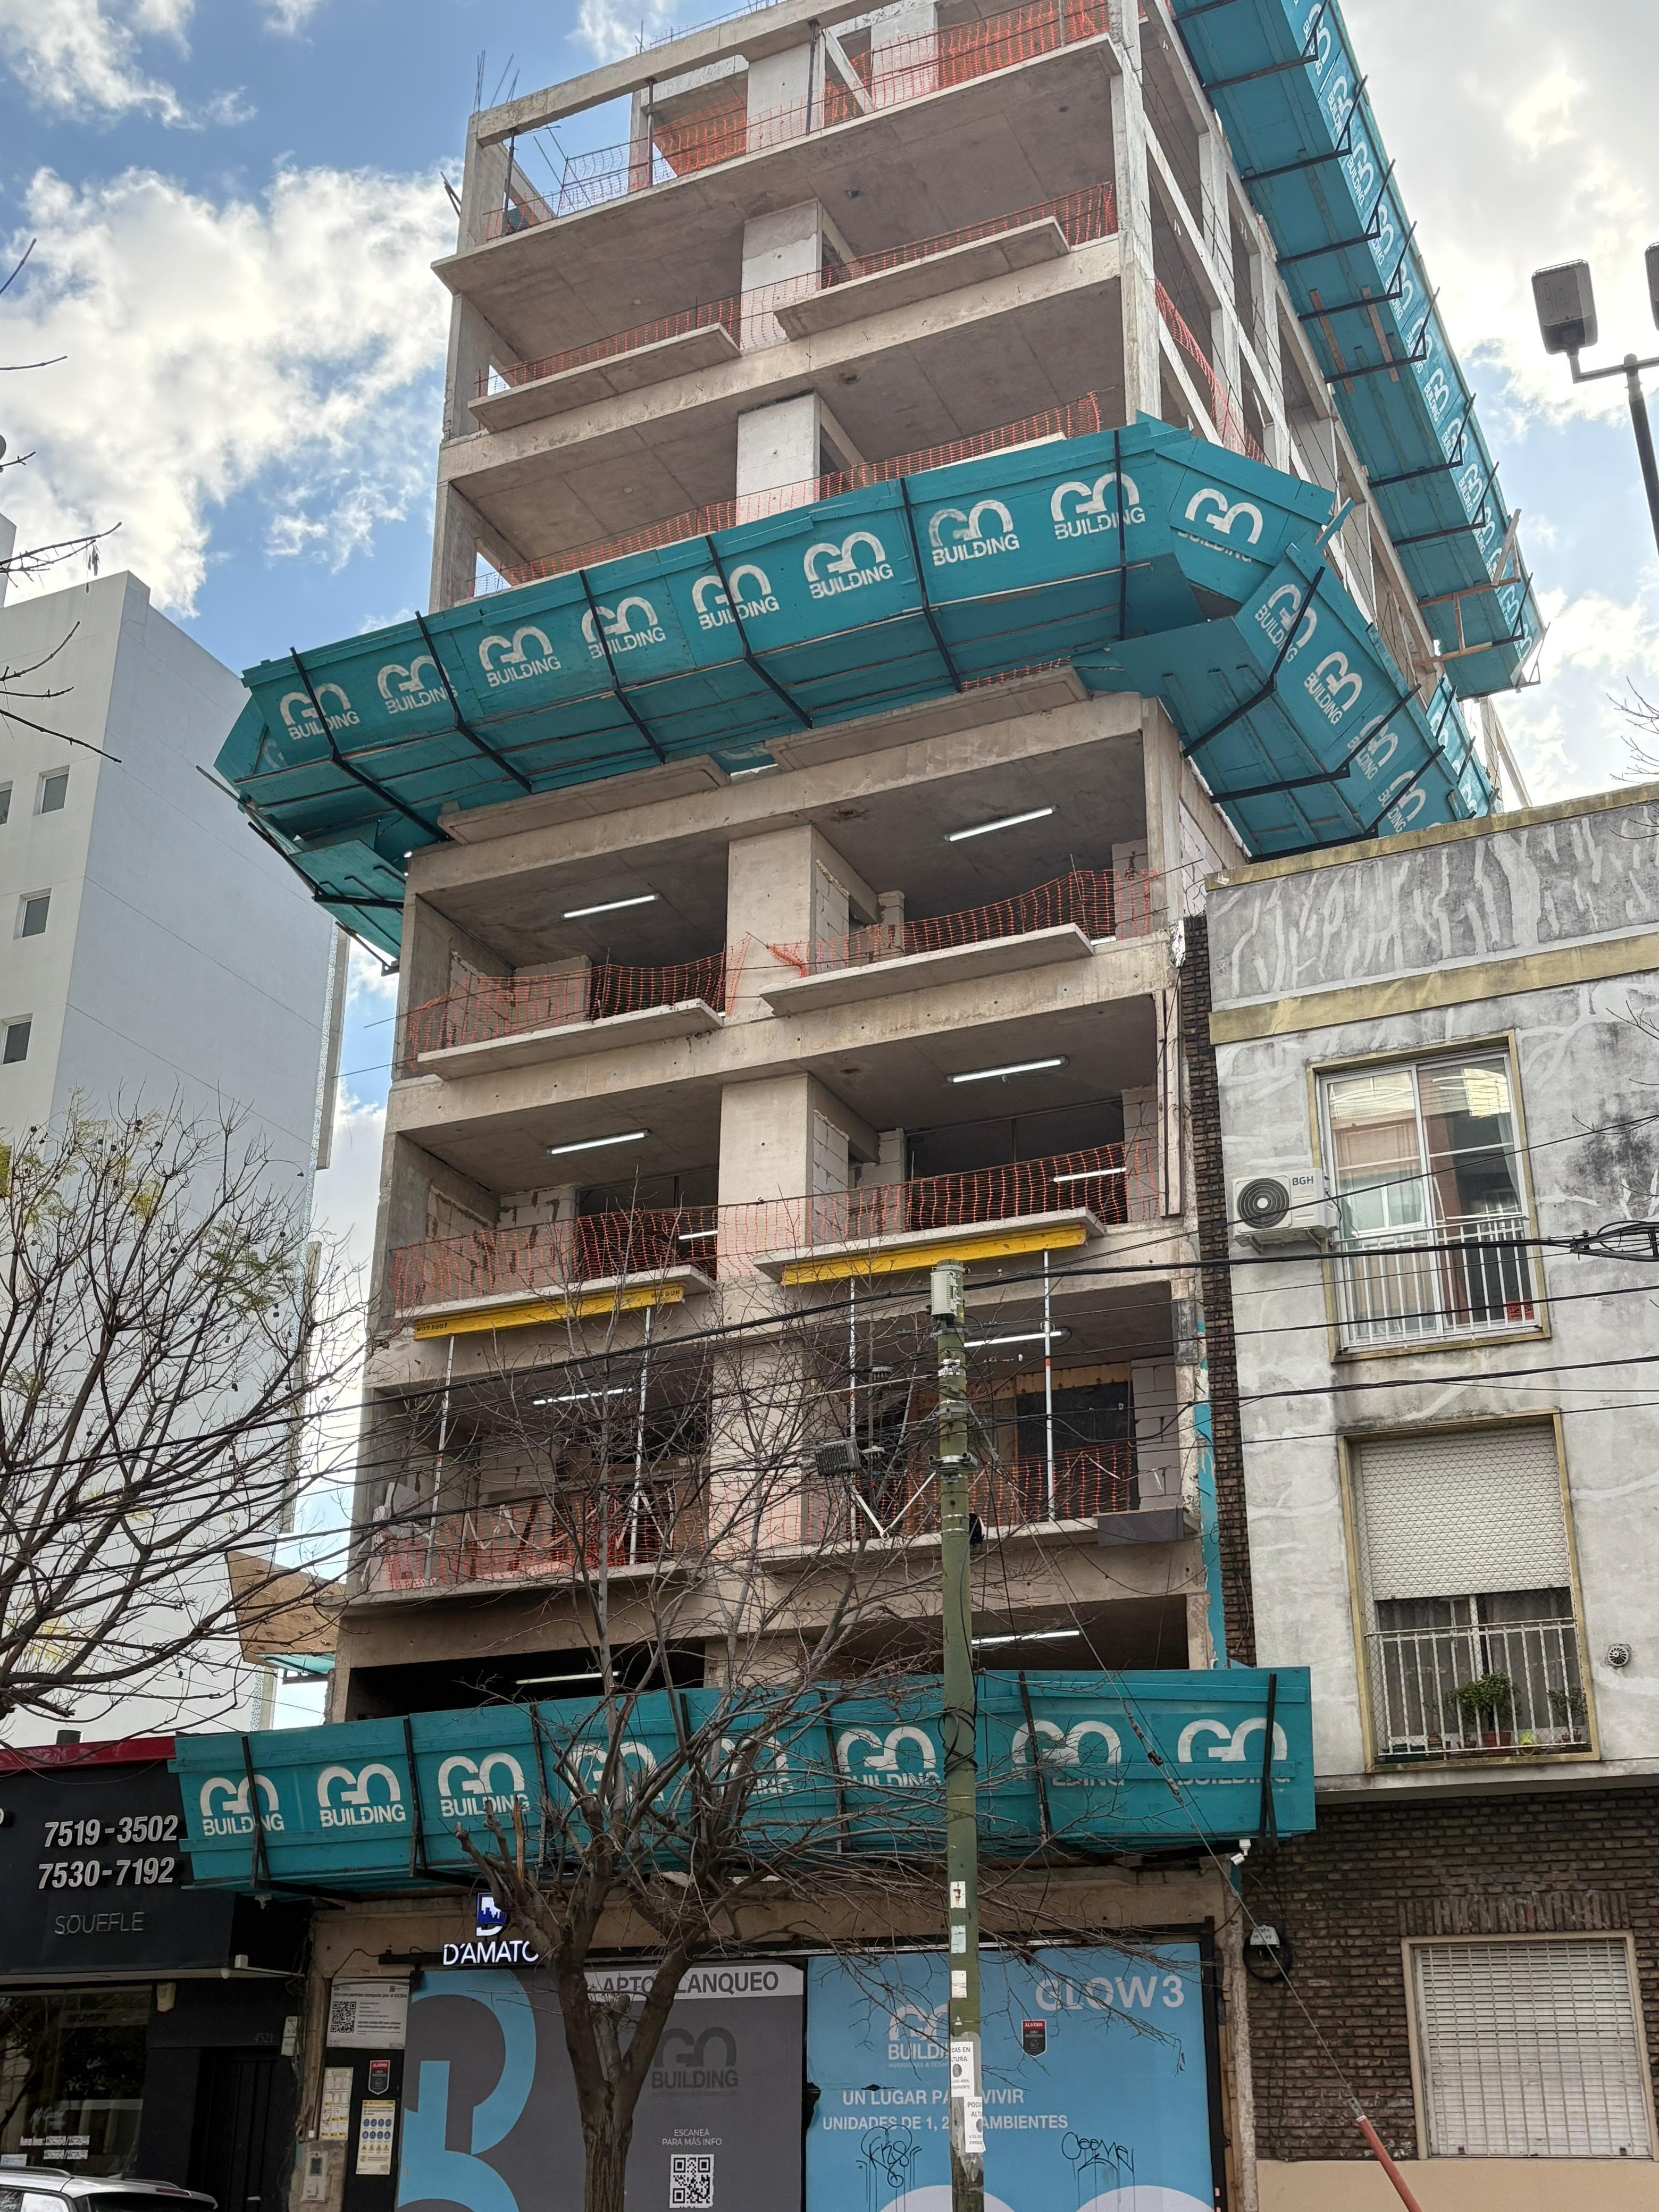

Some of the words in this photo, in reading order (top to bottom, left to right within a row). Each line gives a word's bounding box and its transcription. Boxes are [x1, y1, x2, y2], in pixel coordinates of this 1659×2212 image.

[1347, 156, 1365, 207] BUILDING
[1423, 382, 1440, 422] BUILDING
[1054, 507, 1145, 540] BUILDING
[933, 534, 1019, 566] BUILDING
[809, 563, 893, 599] BUILDING
[698, 596, 780, 631] BUILDING
[486, 656, 562, 688] BUILDING
[384, 683, 458, 715] BUILDING
[1304, 672, 1343, 725] BUILDING
[1292, 1176, 1313, 1186] BGH
[320, 1804, 406, 1828] BUILDING
[440, 1794, 530, 1817] BUILDING
[44, 1815, 179, 1847] 7519-3502
[202, 1813, 285, 1836] BUILDNG
[38, 1857, 175, 1889] 7530-7192
[651, 2069, 739, 2089] BUILDING
[843, 2090, 866, 2106] UN
[870, 2090, 927, 2105] LUGAR
[982, 2088, 1025, 2104] VIVIR
[674, 2127, 710, 2136] ESCANEÁ
[823, 2116, 898, 2130] UNIDADES
[901, 2116, 921, 2130] DE
[981, 2114, 1069, 2129] AMBIENTES
[684, 2136, 701, 2146] MÁS
